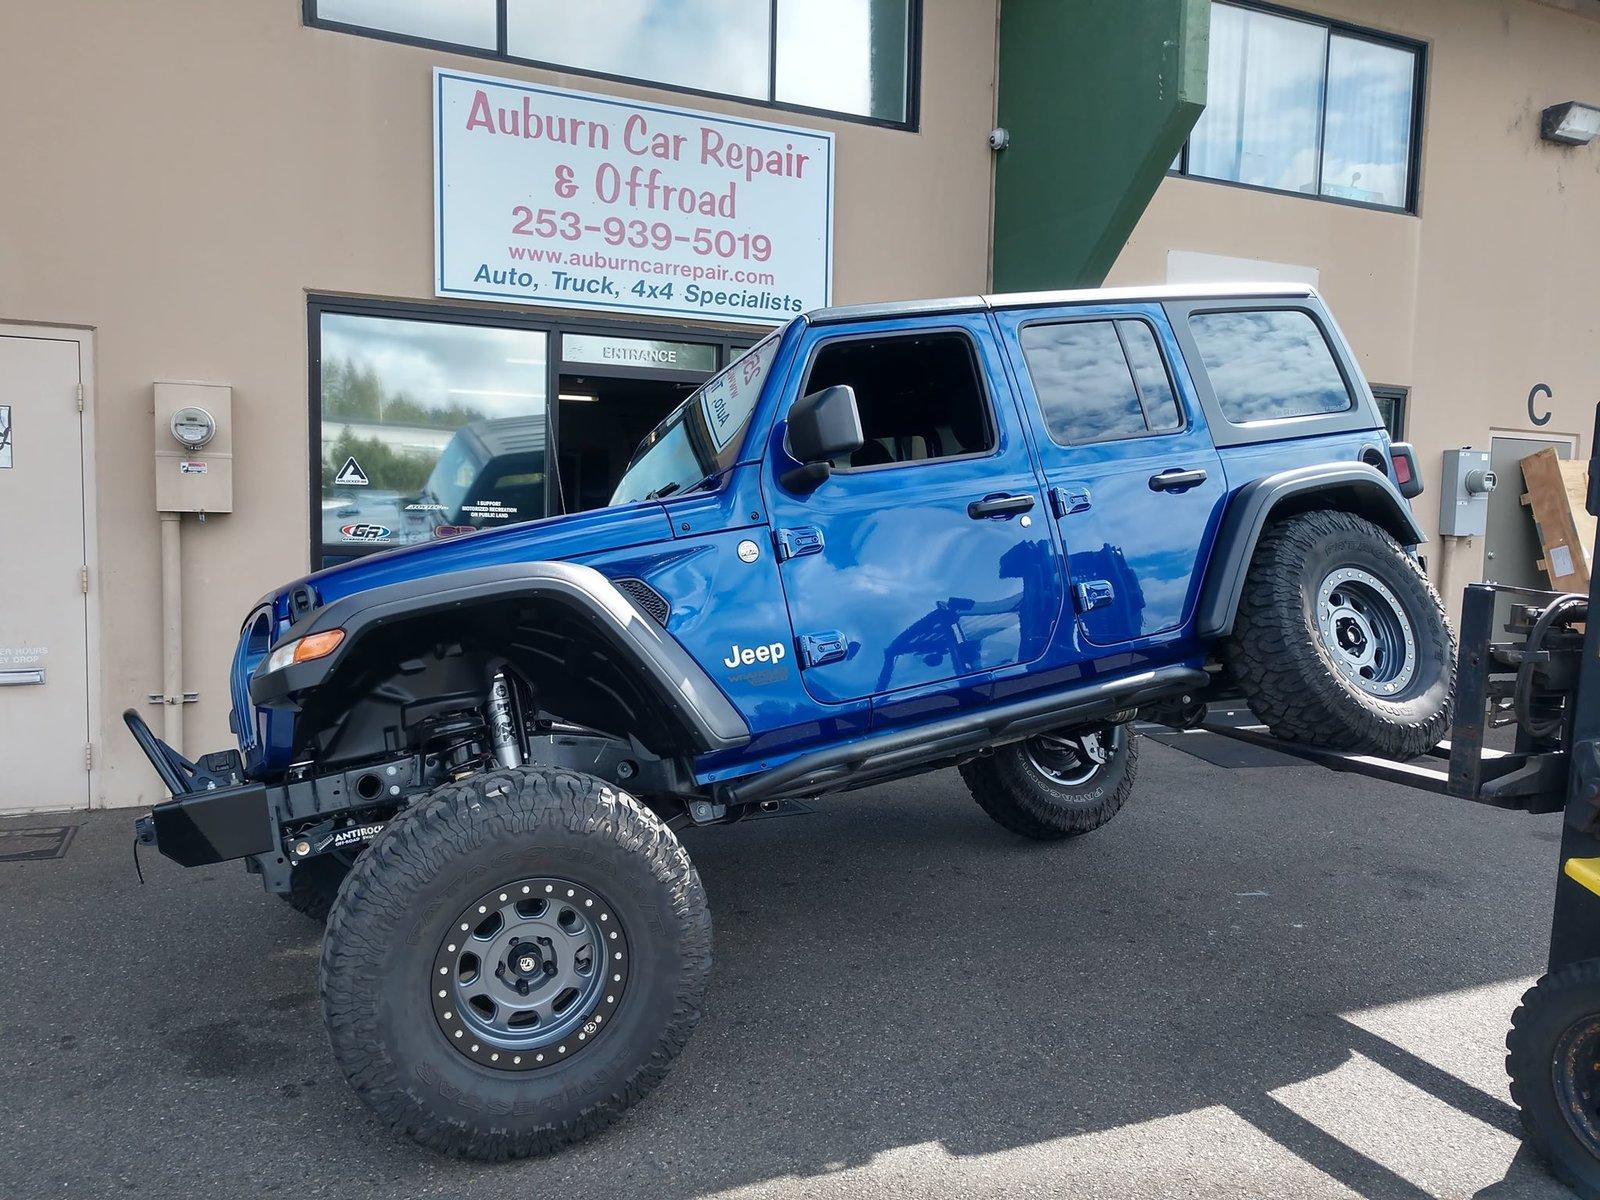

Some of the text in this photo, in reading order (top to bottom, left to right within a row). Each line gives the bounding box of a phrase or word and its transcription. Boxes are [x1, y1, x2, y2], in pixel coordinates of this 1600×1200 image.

[466, 89, 809, 182] Auburn Car Repair
[554, 162, 736, 219] & Offroad
[512, 205, 772, 262] 253-939-5019
[474, 264, 802, 313] Auto, Truck, 4x4 Specialists
[508, 246, 774, 286] www.auburncarrepair.com
[602, 346, 677, 362] ENTRANCE
[1528, 383, 1552, 426] C
[724, 642, 785, 668] Jeep
